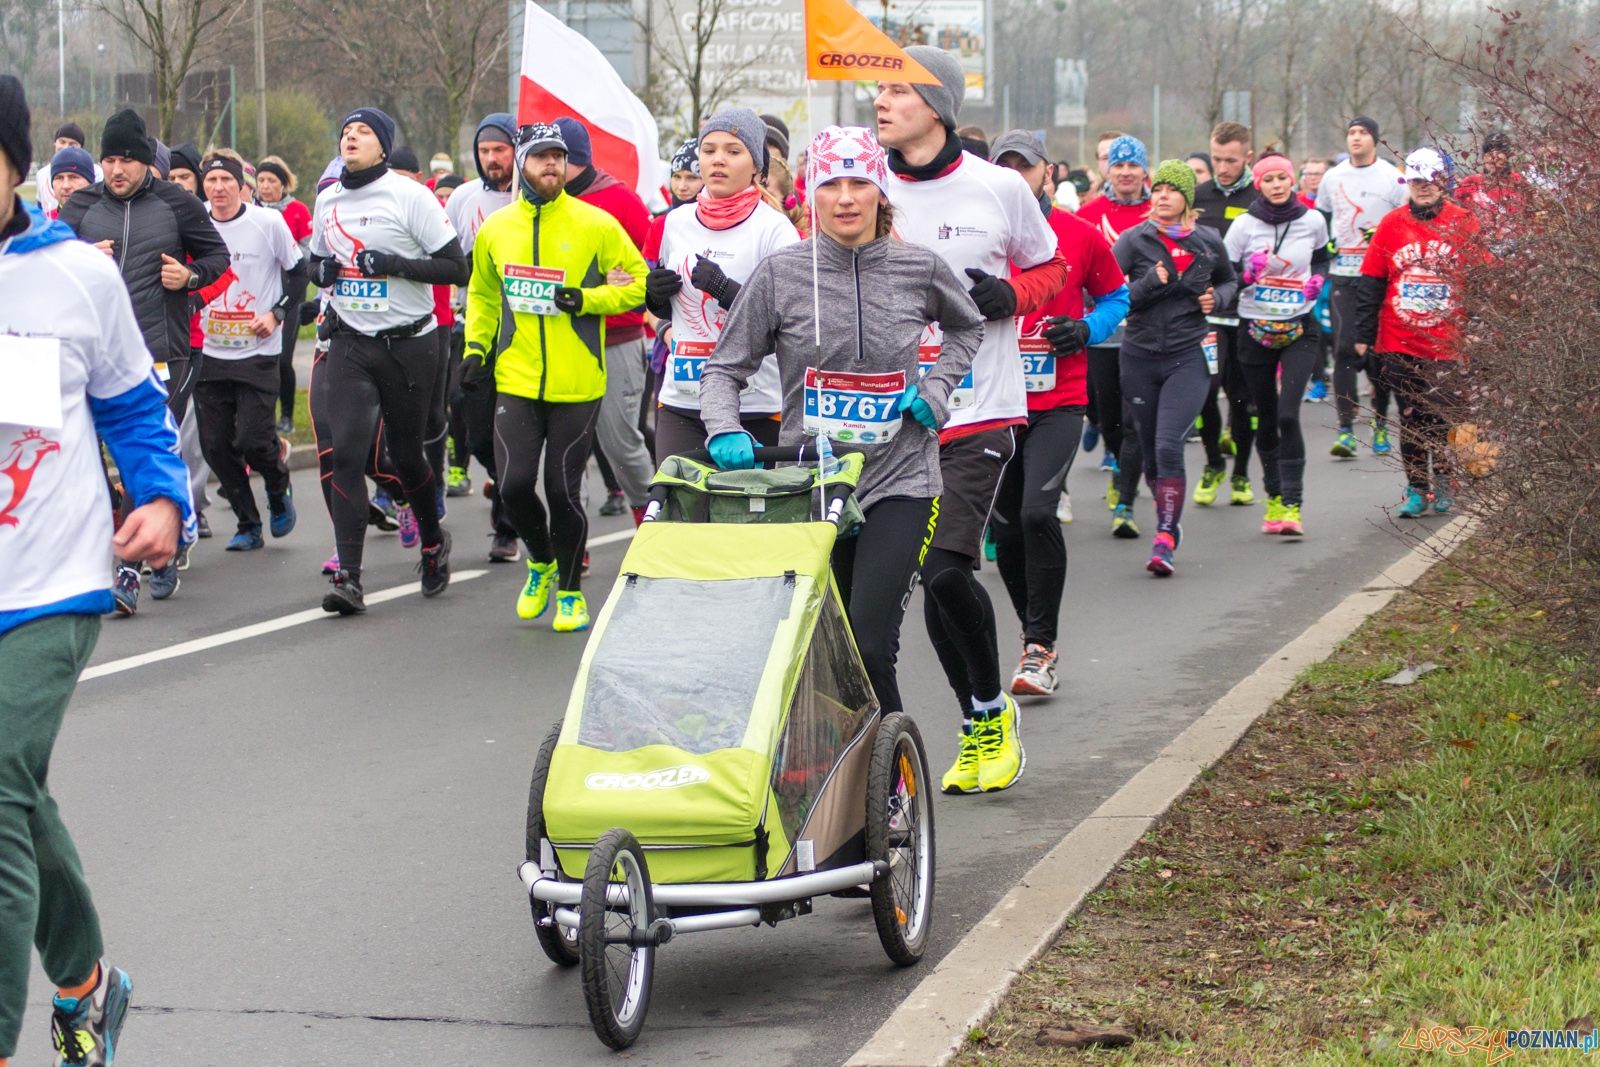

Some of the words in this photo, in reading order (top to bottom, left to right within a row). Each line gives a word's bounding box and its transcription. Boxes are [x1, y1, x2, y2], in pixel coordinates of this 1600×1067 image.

[819, 53, 904, 70] CROOZER
[341, 281, 382, 297] 6012
[508, 280, 556, 299] 4804
[1260, 289, 1298, 302] 4641
[213, 323, 250, 335] 6242
[1021, 356, 1048, 374] 67
[807, 398, 815, 406] E
[820, 394, 896, 420] 8767
[586, 765, 711, 790] CROOZER
